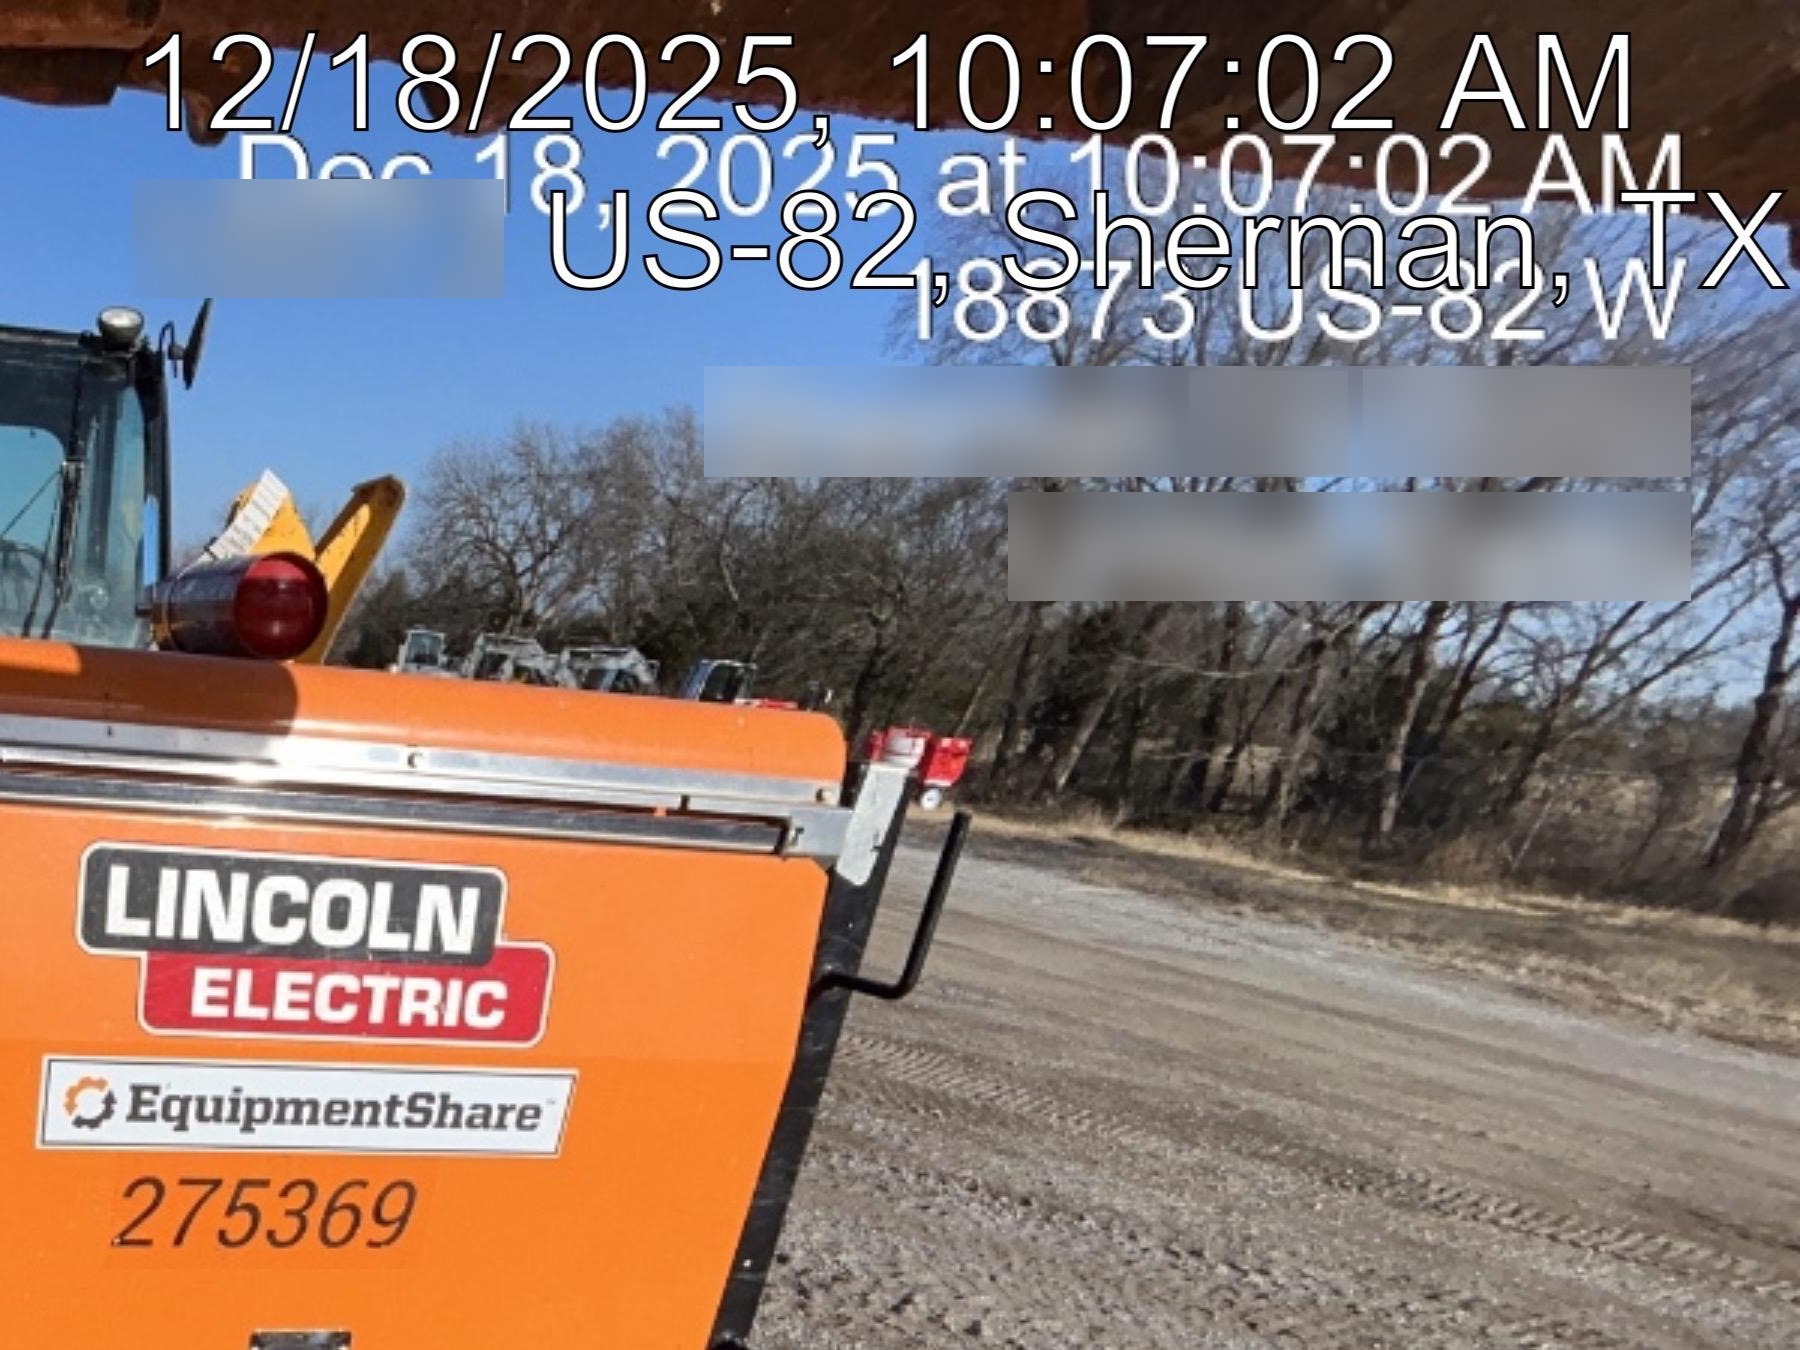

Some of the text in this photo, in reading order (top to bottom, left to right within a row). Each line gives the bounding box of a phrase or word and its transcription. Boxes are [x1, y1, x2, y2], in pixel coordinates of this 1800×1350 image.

[105, 864, 480, 954] LINCOLN
[191, 968, 509, 1030] ELECTRIC
[126, 1083, 542, 1134] EquipmentShare
[110, 1176, 417, 1248] 275369
